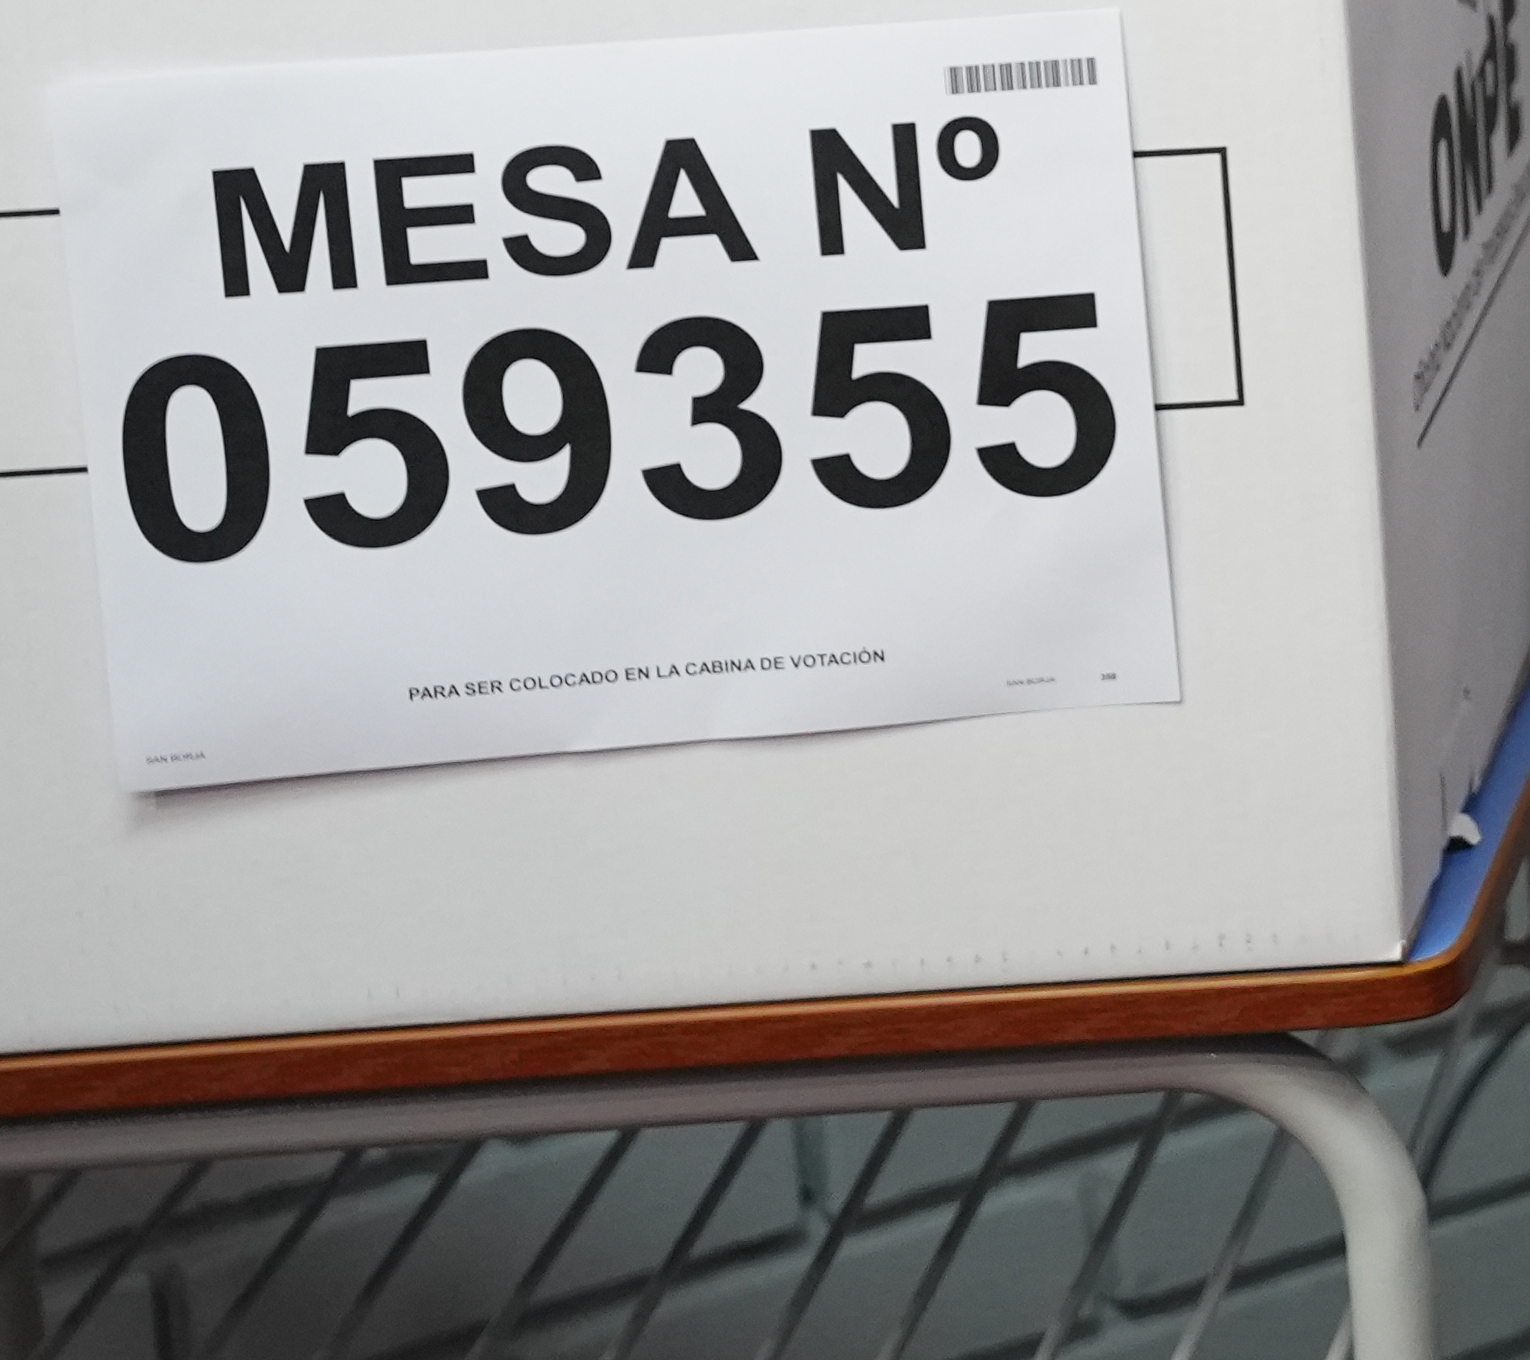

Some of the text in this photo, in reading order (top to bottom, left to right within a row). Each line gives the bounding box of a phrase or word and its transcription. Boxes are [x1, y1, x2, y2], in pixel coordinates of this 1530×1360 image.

[212, 138, 759, 298] MESA
[122, 292, 1117, 564] 059355
[408, 647, 885, 702] PARA SER COLOCADO EN LA CABINA DE VOTACIÓN
